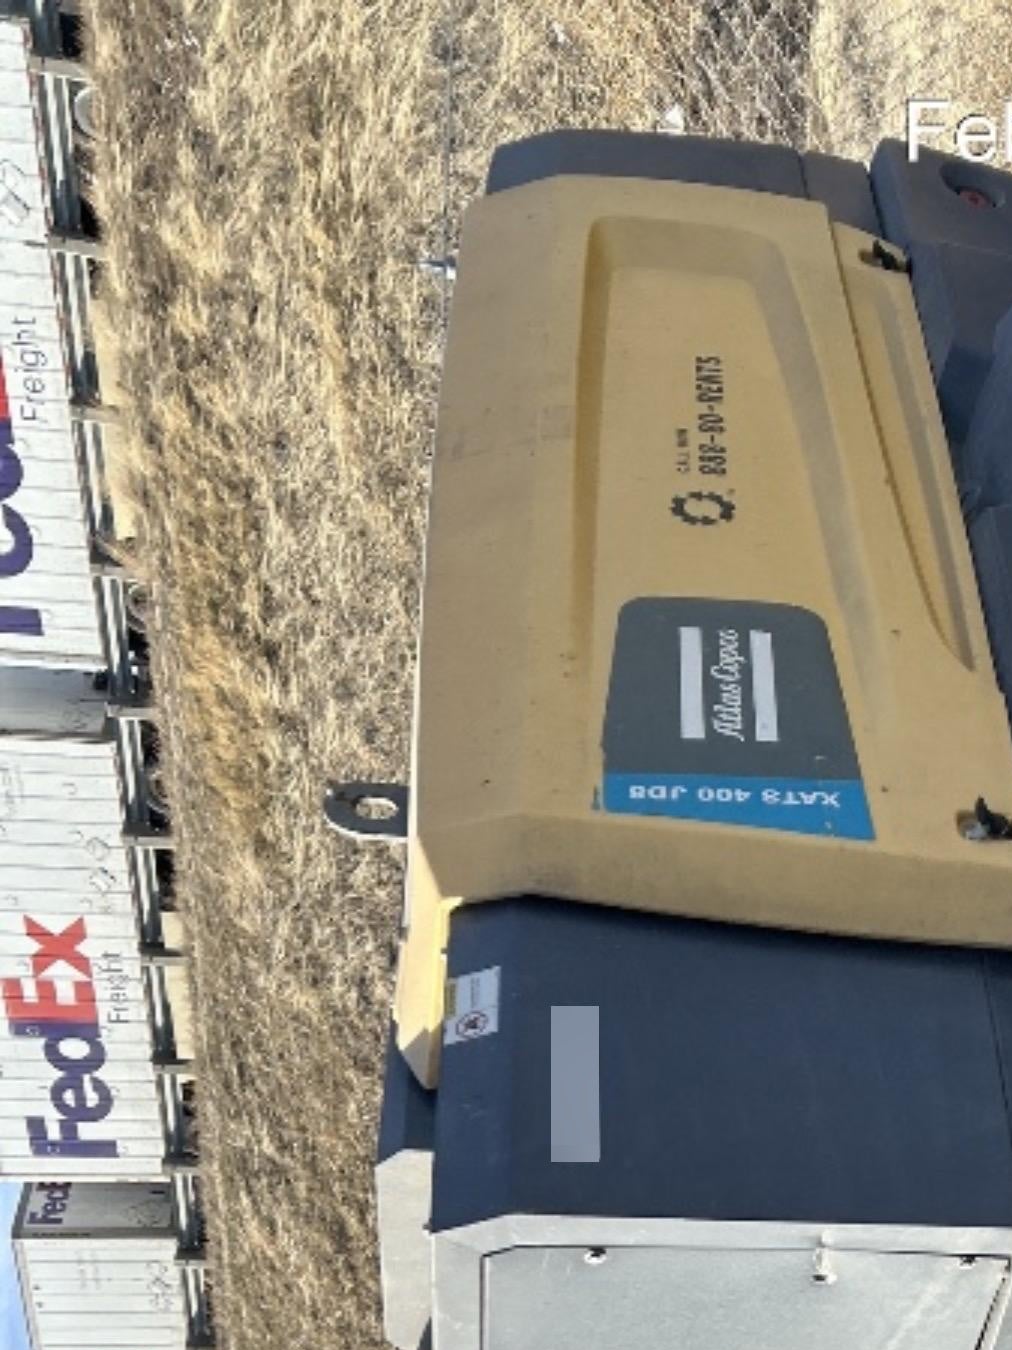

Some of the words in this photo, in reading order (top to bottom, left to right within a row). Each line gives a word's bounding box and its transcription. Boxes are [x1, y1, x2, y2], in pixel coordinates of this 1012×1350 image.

[10, 316, 47, 423] Freight
[710, 629, 746, 682] Copco
[710, 684, 745, 742] Atlas
[698, 786, 752, 802] 400
[98, 950, 130, 1024] Freight
[2, 914, 120, 1158] FedEx
